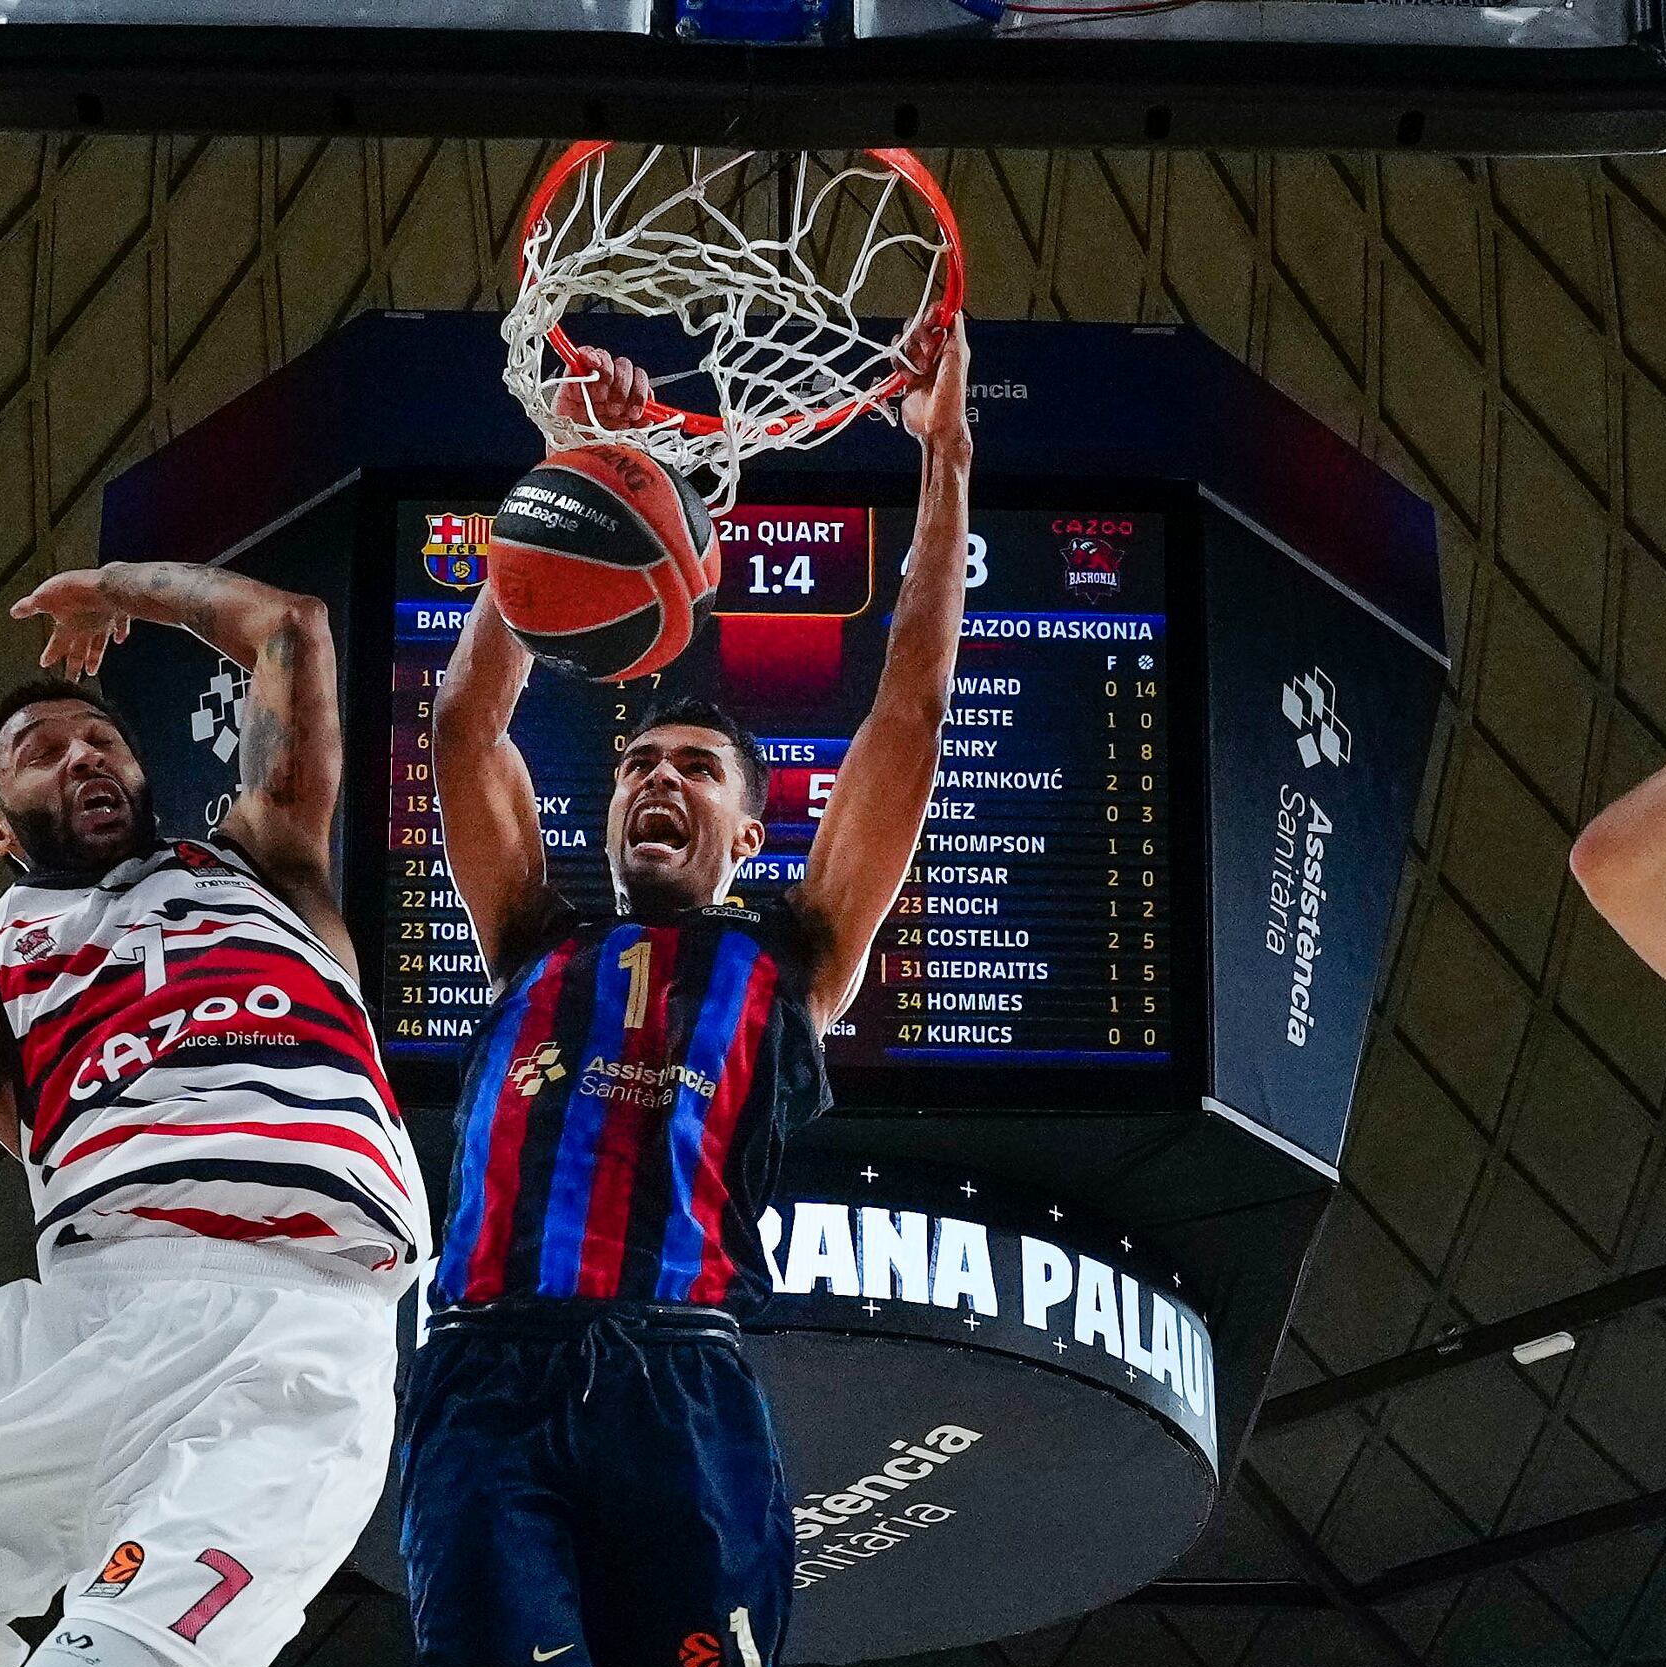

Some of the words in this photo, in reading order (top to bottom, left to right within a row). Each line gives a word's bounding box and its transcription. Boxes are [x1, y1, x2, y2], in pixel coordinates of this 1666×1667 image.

[555, 492, 620, 533] AIRLINES
[719, 521, 749, 541] 2n
[757, 520, 845, 546] QUART
[1051, 519, 1133, 535] CAZOO
[748, 554, 815, 595] 1:4
[1068, 571, 1118, 586] BASKONIA
[960, 619, 1032, 638] CAZOO
[1037, 620, 1154, 641] BASKONIA
[1106, 655, 1118, 671] F
[650, 673, 662, 689] 7
[1105, 681, 1118, 698] 0
[1134, 681, 1157, 698] 14
[418, 702, 430, 718] 5
[614, 704, 627, 720] 2
[942, 708, 1014, 727] AIESTE
[1107, 712, 1117, 728] 1
[1140, 713, 1153, 729] 0
[417, 733, 430, 749] 6
[939, 740, 998, 758] ENRY
[1107, 743, 1117, 759] 1
[1140, 744, 1153, 760] 8
[405, 764, 428, 780] 10
[933, 768, 1063, 790] MARINKOVIĆ
[1106, 775, 1118, 791] 2
[1141, 775, 1154, 791] 0
[406, 796, 428, 812] 13
[807, 774, 836, 818] 5
[927, 796, 976, 820] DÍEZ
[1106, 805, 1119, 822] 0
[1141, 806, 1154, 823] 3
[401, 828, 427, 845] 20
[926, 834, 1046, 854] THOMPSON
[1109, 838, 1119, 855] 1
[1142, 839, 1154, 856] 6
[405, 860, 426, 877] 21
[927, 866, 1009, 885] KOTSAR
[1107, 869, 1119, 886] 2
[1142, 870, 1154, 887] 0
[1264, 782, 1306, 958] Sanitària
[401, 891, 426, 908] 22
[898, 897, 922, 914] 23
[927, 896, 999, 915] ENOCH
[1110, 900, 1119, 917] 1
[1142, 901, 1155, 918] 2
[400, 923, 425, 940] 23
[1285, 798, 1334, 1049] Assistència
[897, 928, 922, 946] 24
[926, 928, 1031, 948] COSTELLO
[1108, 932, 1120, 949] 2
[1143, 933, 1155, 950] 5
[399, 955, 424, 972] 24
[900, 960, 922, 978] 31
[926, 960, 1049, 981] GIEDRAITIS
[1110, 964, 1119, 981] 1
[1143, 964, 1155, 982] 5
[402, 986, 424, 1004] 31
[618, 941, 653, 1029] 1
[897, 992, 922, 1010] 34
[926, 992, 1024, 1012] HOMMES
[1110, 996, 1119, 1013] 1
[1144, 997, 1156, 1014] 5
[396, 1020, 423, 1037] 46
[898, 1024, 923, 1042] 47
[926, 1024, 1014, 1043] KURUCS
[1108, 1028, 1121, 1045] 0
[1144, 1029, 1156, 1046] 0
[69, 985, 292, 1101] CAZOO
[225, 1031, 300, 1048] Disfruta.
[584, 1054, 718, 1099] Assistncia
[1020, 1234, 1206, 1418] PALAU
[168, 1547, 255, 1646] 7
